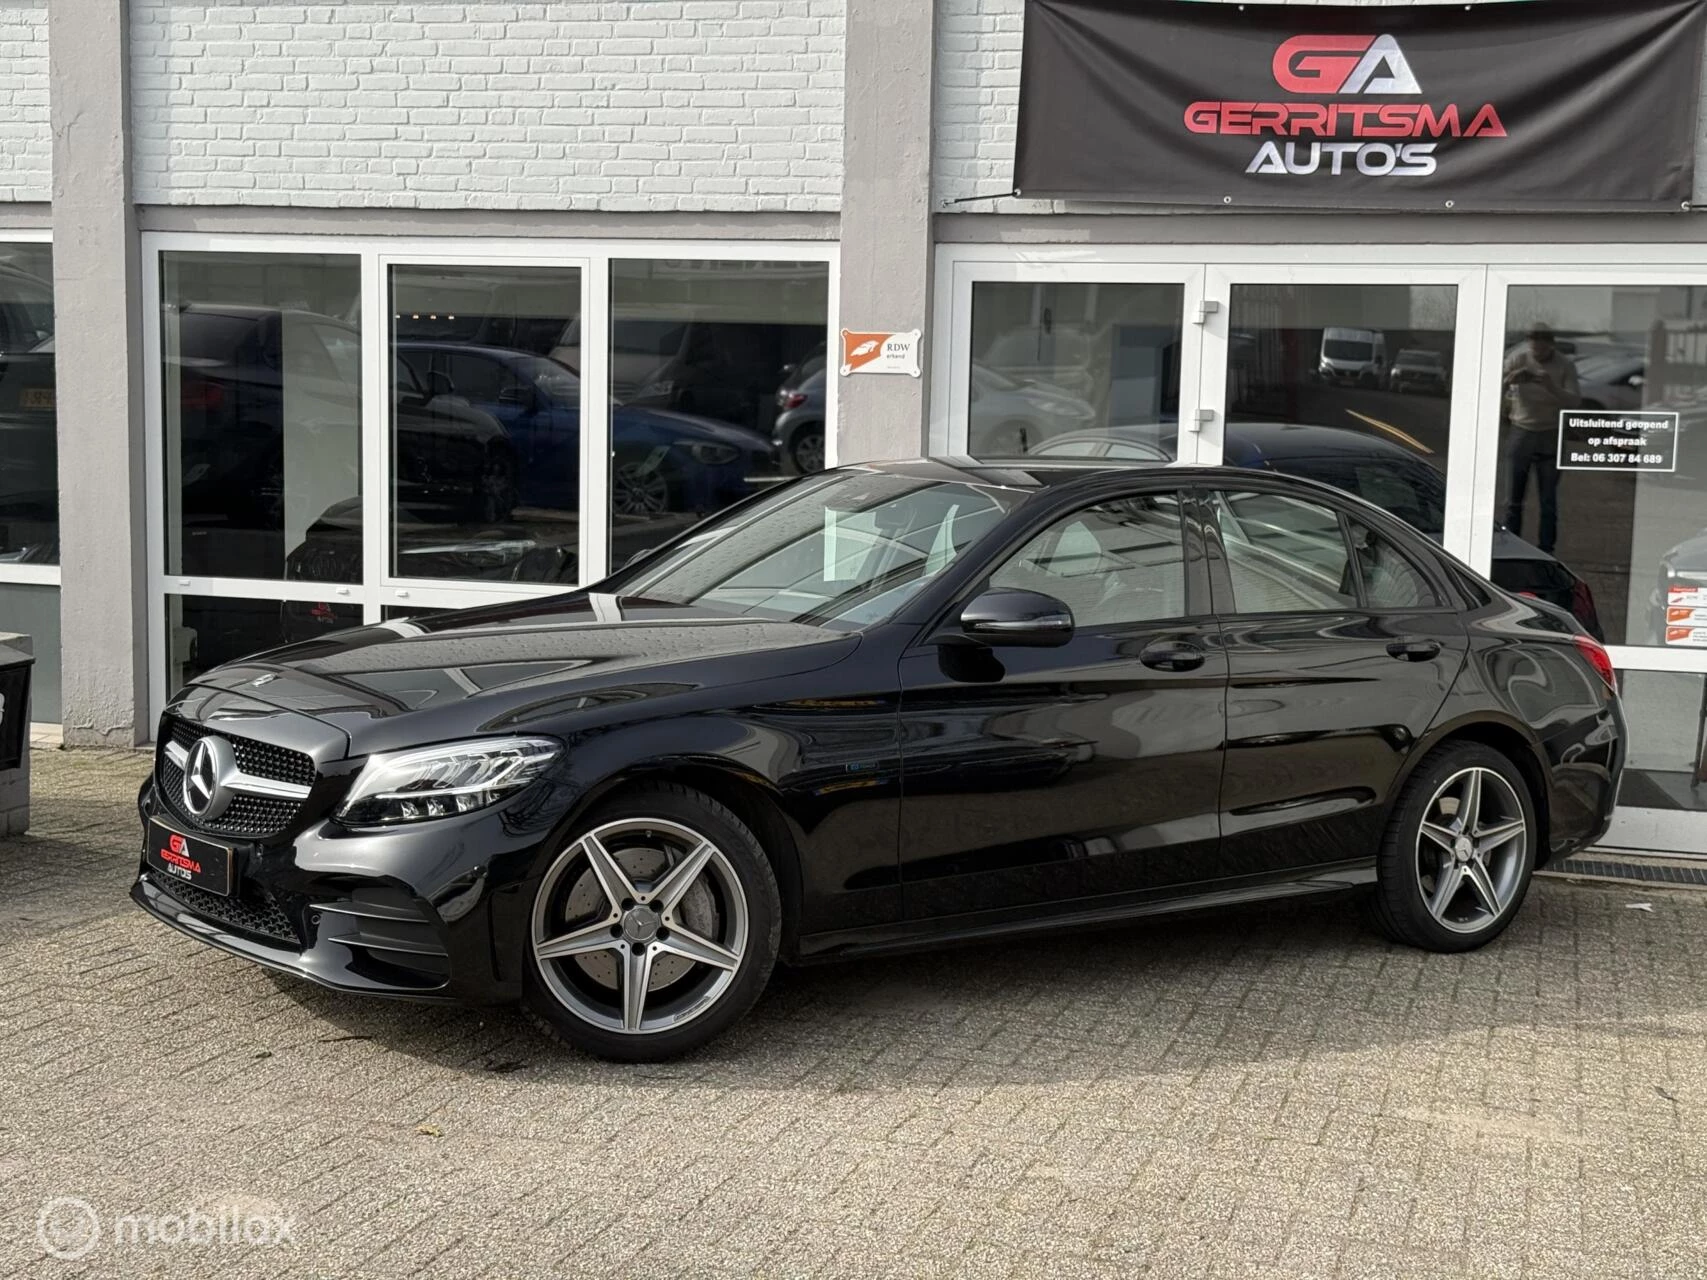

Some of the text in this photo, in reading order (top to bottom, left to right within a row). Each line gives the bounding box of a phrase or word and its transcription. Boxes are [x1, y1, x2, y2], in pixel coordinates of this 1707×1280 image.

[1272, 33, 1423, 95] GA
[1183, 101, 1508, 137] GERRITSMA
[1244, 140, 1438, 177] AUTO'S
[887, 343, 911, 352] RDW
[1569, 418, 1669, 431] Uitsluitend geopend
[1587, 436, 1648, 447] op afspraak
[1570, 452, 1663, 464] Bel: 06 307 84 689
